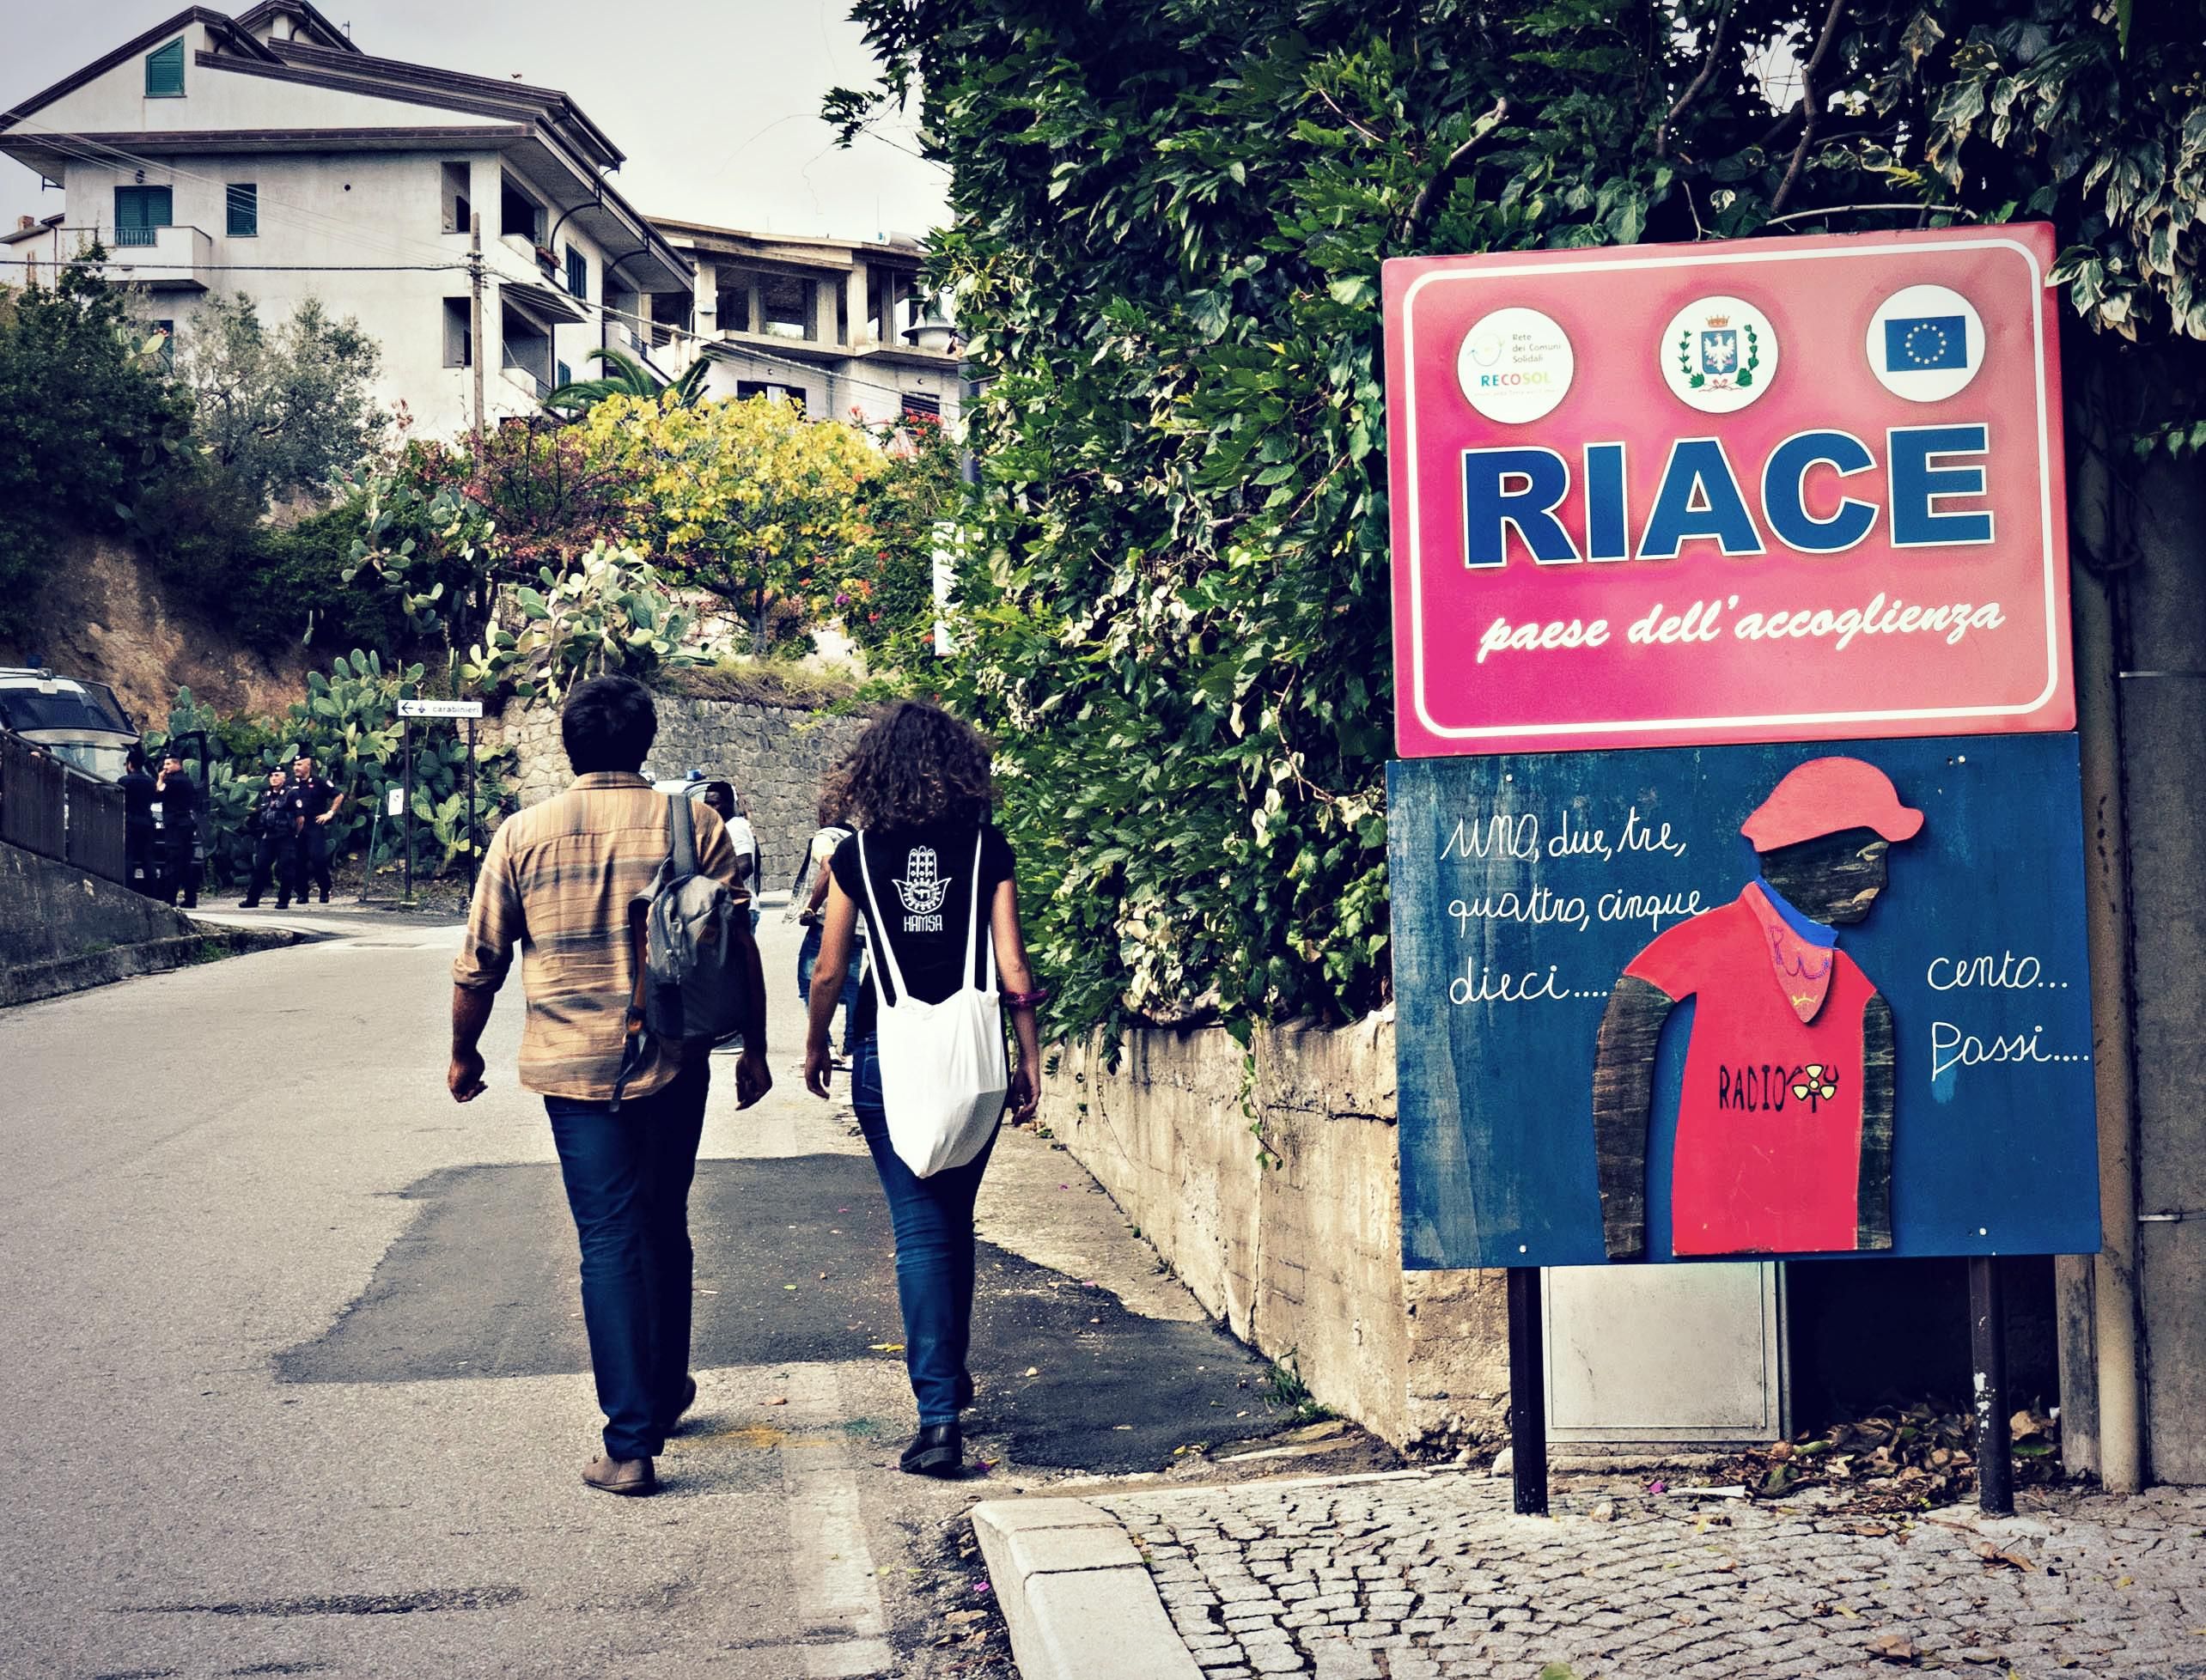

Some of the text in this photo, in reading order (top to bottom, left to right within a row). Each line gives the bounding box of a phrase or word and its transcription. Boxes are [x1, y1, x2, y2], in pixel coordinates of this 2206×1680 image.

[1512, 343, 1562, 352] dei Comuni
[1513, 355, 1544, 363] Solidali
[1480, 371, 1551, 387] RECOSOL
[1460, 423, 1996, 569] RIACE
[1476, 593, 2007, 663] paese dell'accoglienza
[432, 705, 479, 714] carabinieri
[1548, 810, 1613, 862] due,
[1618, 806, 1687, 857] tre,
[903, 915, 943, 933] HAMSA
[1447, 883, 1710, 939] quattro, cinque
[1719, 1064, 1786, 1112] RADIO
